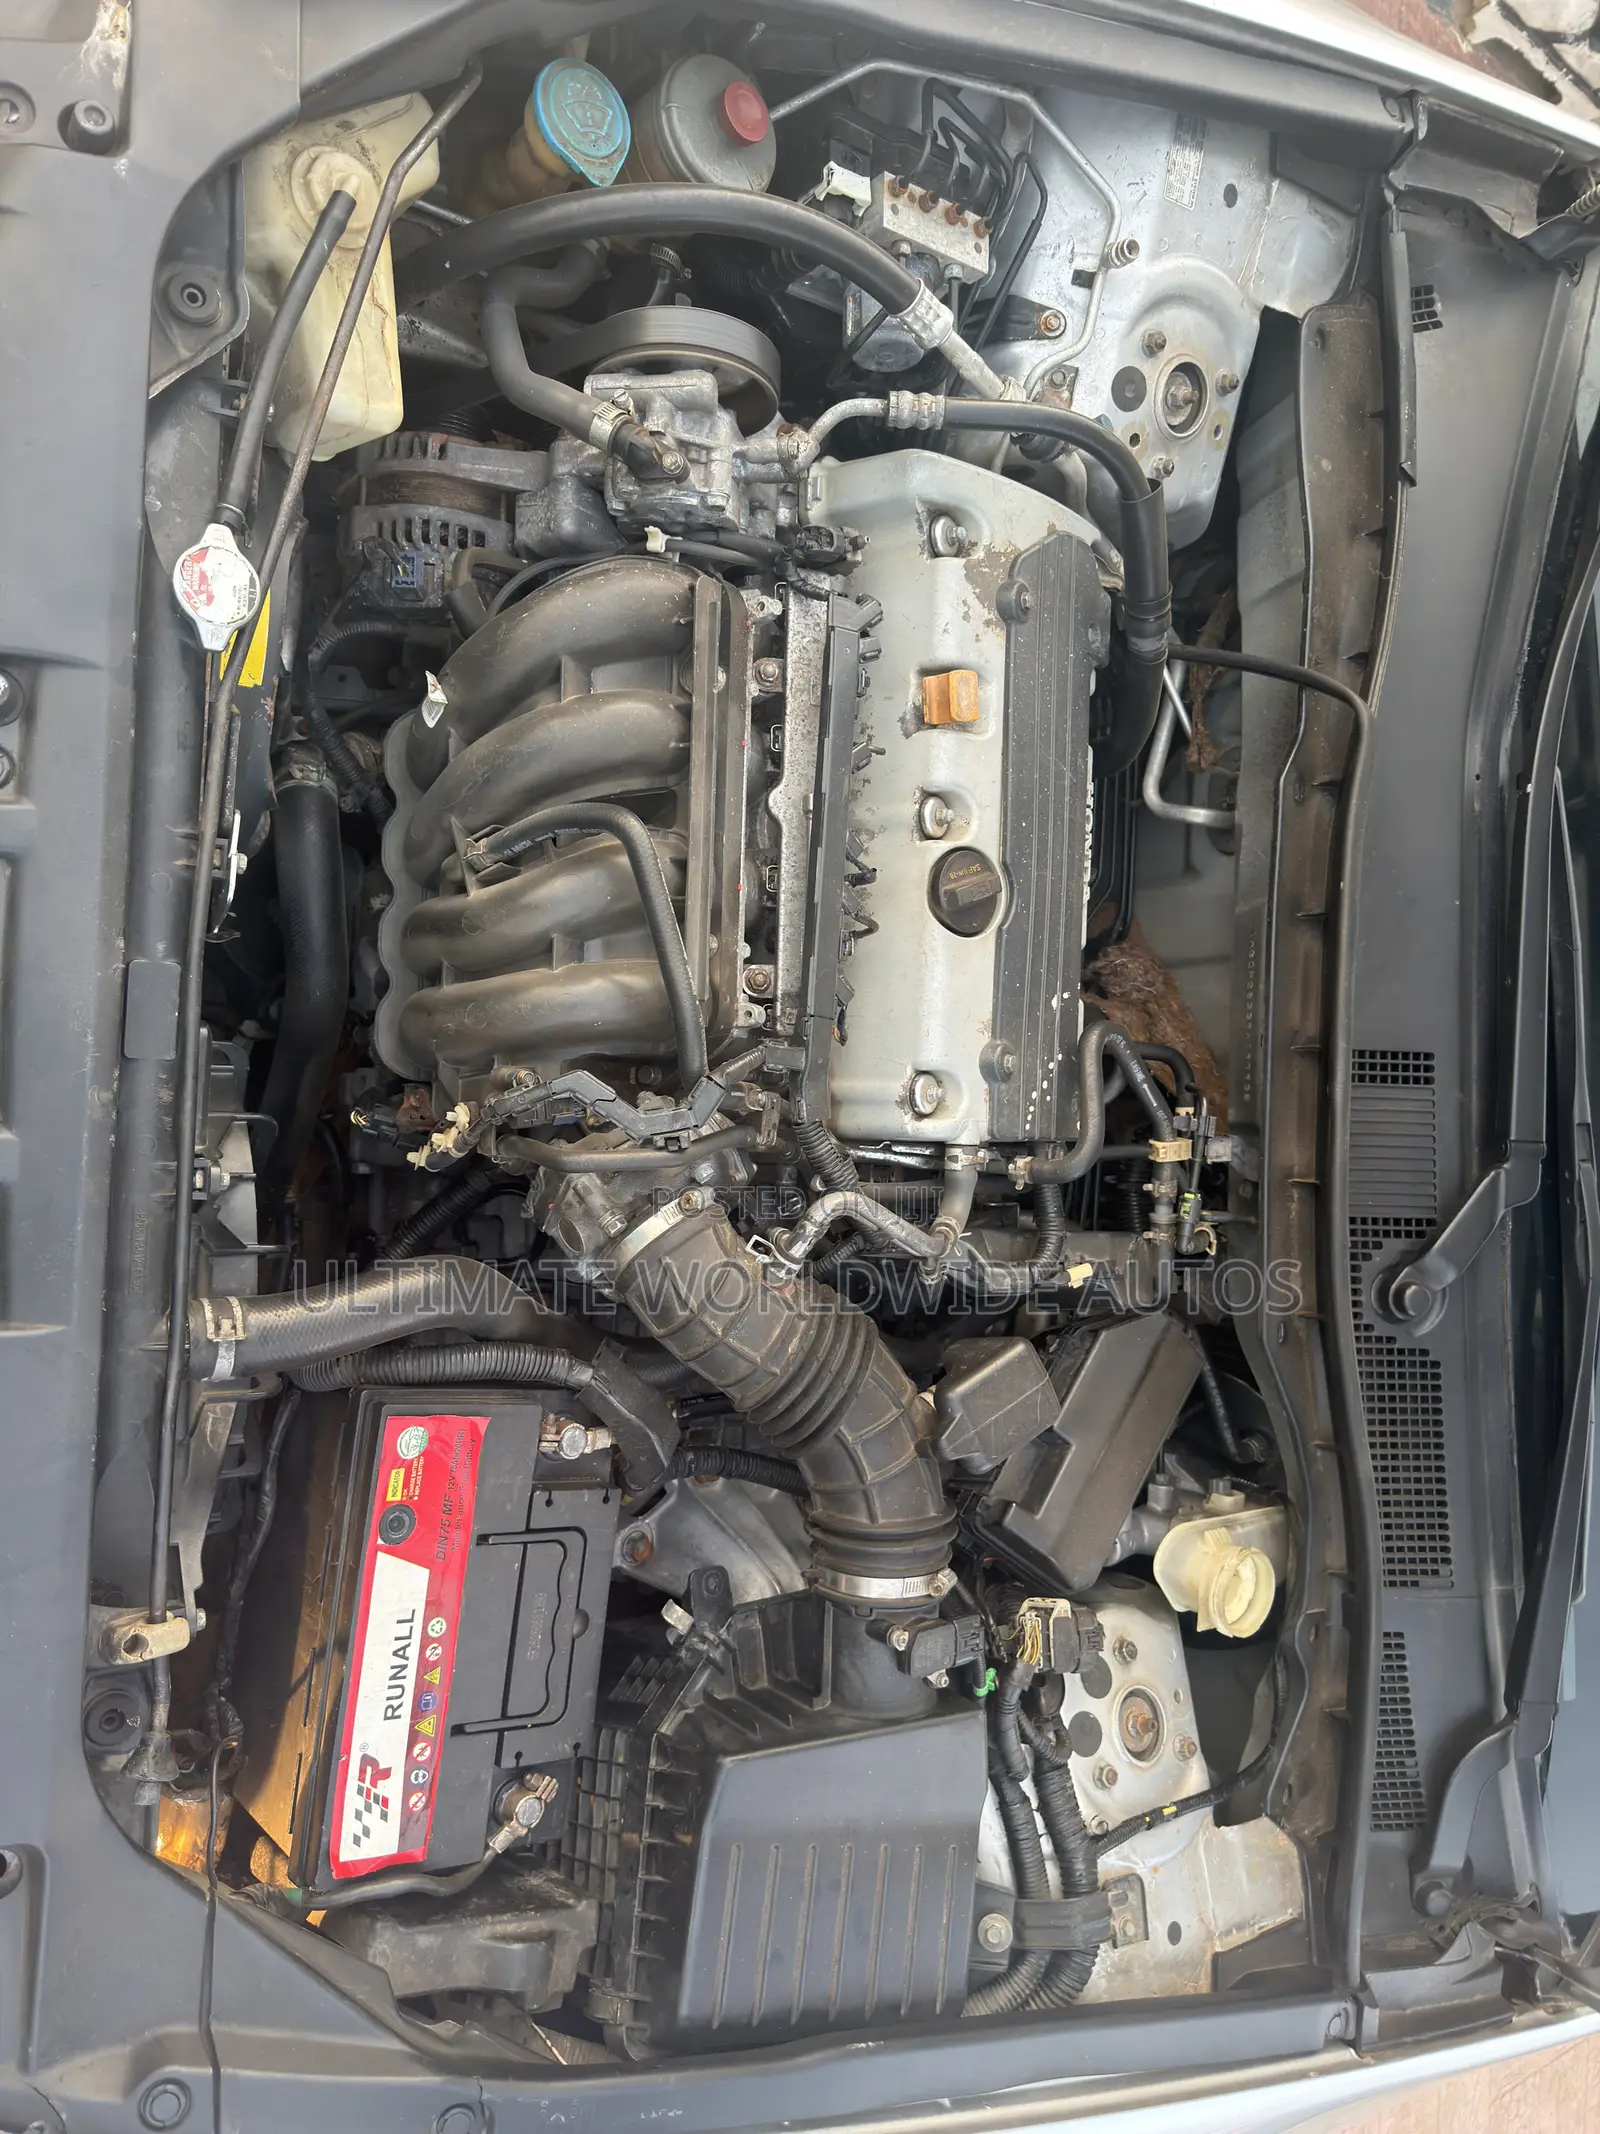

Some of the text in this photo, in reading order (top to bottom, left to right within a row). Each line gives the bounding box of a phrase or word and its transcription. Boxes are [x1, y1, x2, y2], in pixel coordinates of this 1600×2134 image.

[463, 1438, 477, 1469] Battery
[391, 1469, 402, 1499] INDICATOR
[408, 1476, 416, 1496] CHARGE
[447, 1475, 455, 1492] 12V
[443, 1494, 454, 1516] MF
[436, 1518, 451, 1561] DIN75
[383, 1608, 416, 1721] RUNALL
